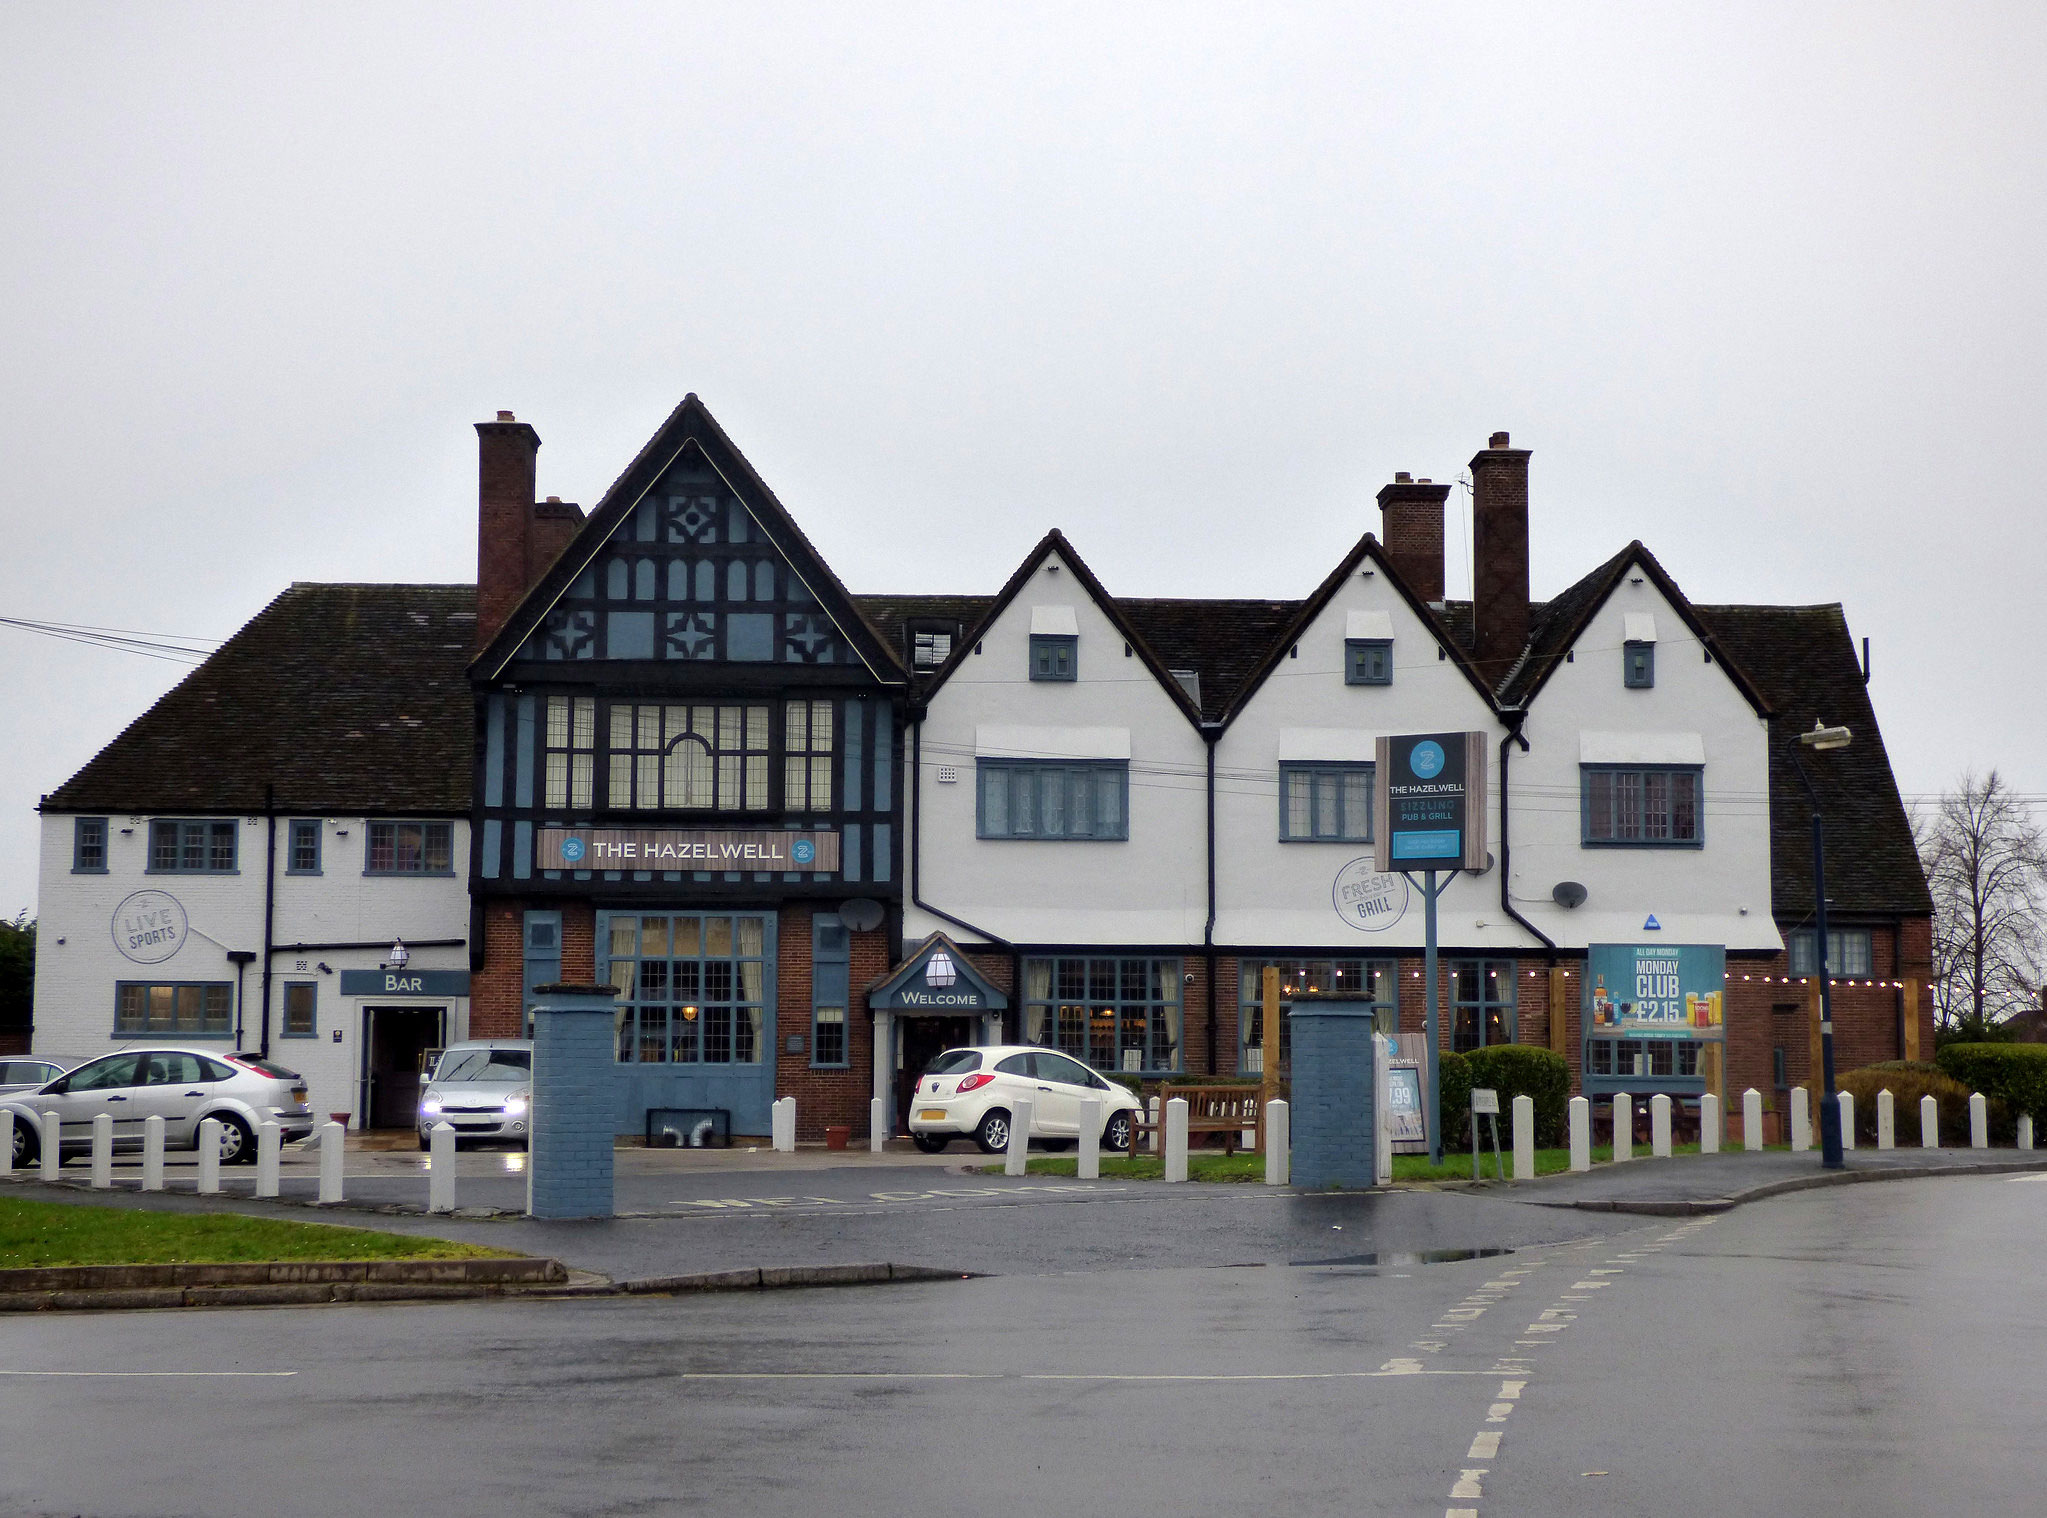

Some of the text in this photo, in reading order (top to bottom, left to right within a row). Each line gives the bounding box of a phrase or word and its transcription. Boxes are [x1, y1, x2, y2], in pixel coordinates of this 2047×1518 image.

[1390, 784, 1464, 794] THE HAZELWELL
[1401, 800, 1455, 811] SIZZLING
[1402, 813, 1419, 821] PUB
[1429, 812, 1453, 820] GRILL
[593, 842, 784, 859] THE HAZELWELL
[1342, 873, 1395, 900] FRESH
[1357, 897, 1392, 918] GRILL
[125, 908, 172, 933] LIVE
[129, 926, 176, 949] SPORTS
[1636, 948, 1678, 956] ALL DAY MONDAY
[1636, 960, 1679, 974] MONDAY
[1636, 975, 1679, 998] CLUB
[1637, 1000, 1679, 1023] £2.15
